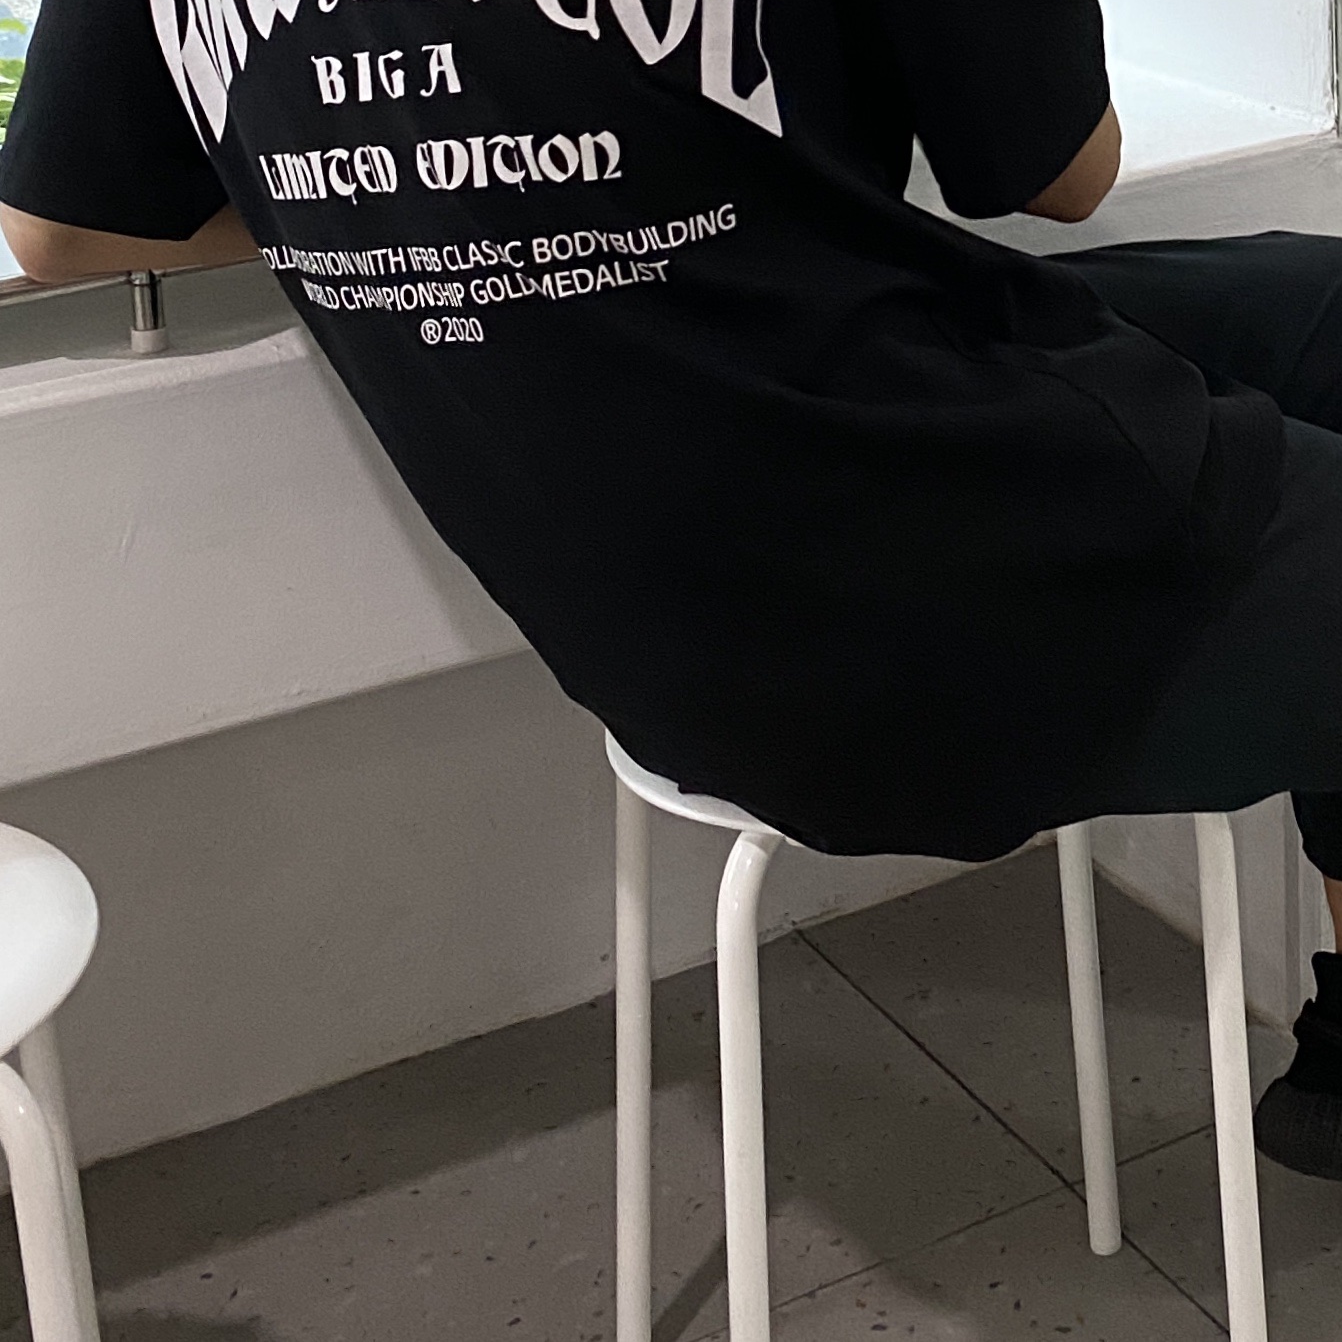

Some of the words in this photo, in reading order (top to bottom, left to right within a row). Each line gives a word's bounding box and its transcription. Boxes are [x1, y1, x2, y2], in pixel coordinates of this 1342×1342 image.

[310, 48, 406, 105] BIG
[419, 42, 462, 99] A
[258, 144, 398, 206] LIMITED
[416, 129, 623, 193] EDITION
[350, 246, 407, 277] WITH
[407, 246, 442, 272] IFBB
[531, 203, 737, 264] BODYBUILDING
[469, 271, 536, 305] GOLD
[528, 259, 669, 300] MEDALIST
